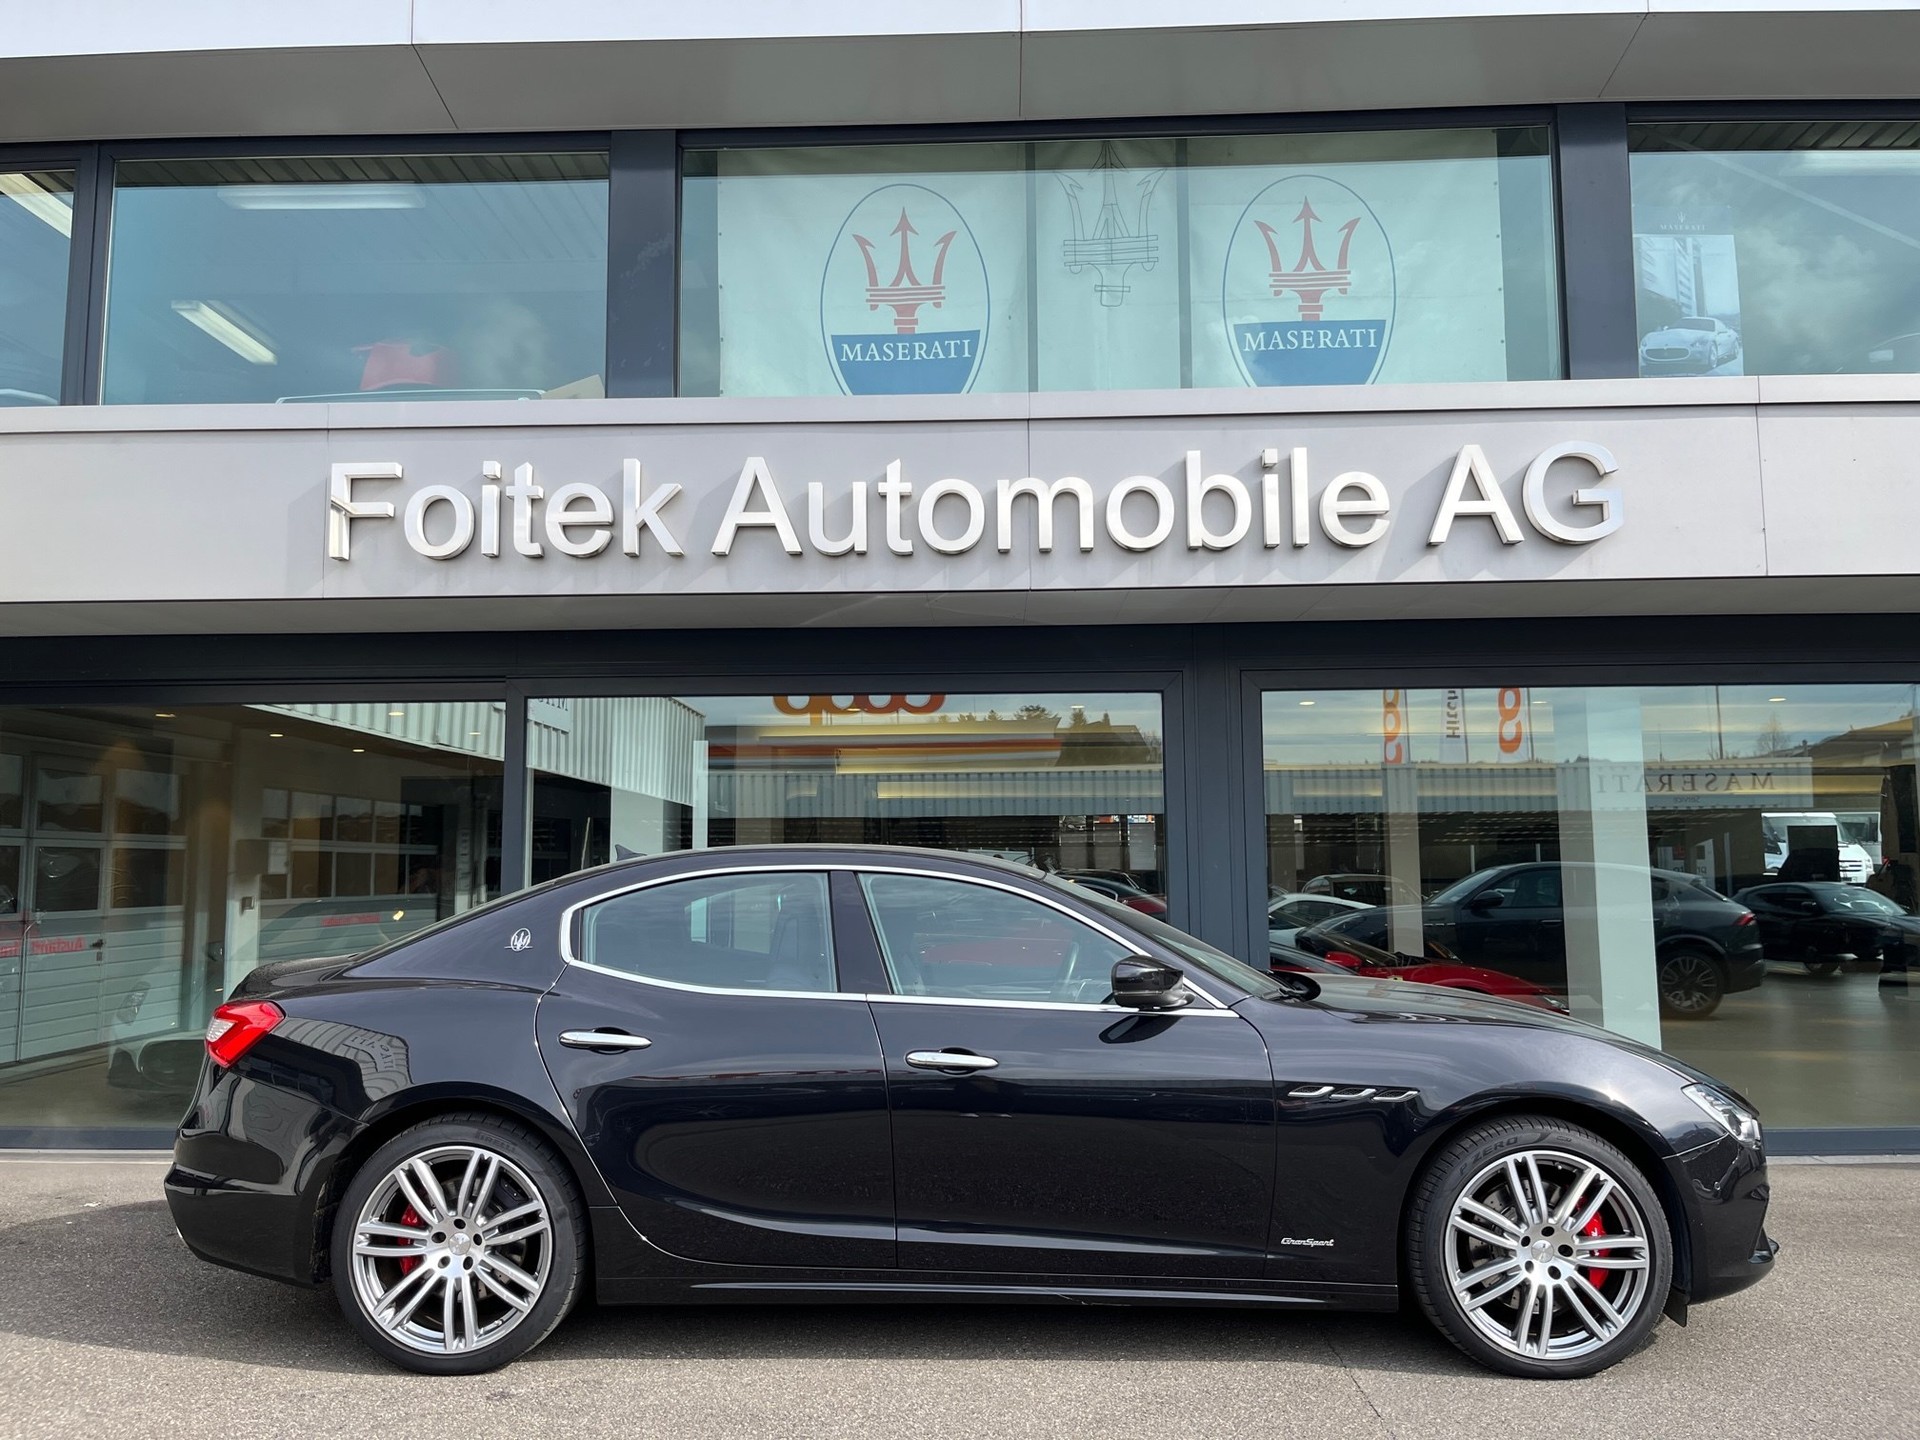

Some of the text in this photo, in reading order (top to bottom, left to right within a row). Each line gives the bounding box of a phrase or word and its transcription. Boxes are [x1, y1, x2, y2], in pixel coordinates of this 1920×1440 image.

[840, 339, 972, 362] MASERATI
[1243, 328, 1378, 352] MASERATI
[329, 440, 1625, 561] Foitek Automobile AG
[1280, 1237, 1334, 1248] GranSport
